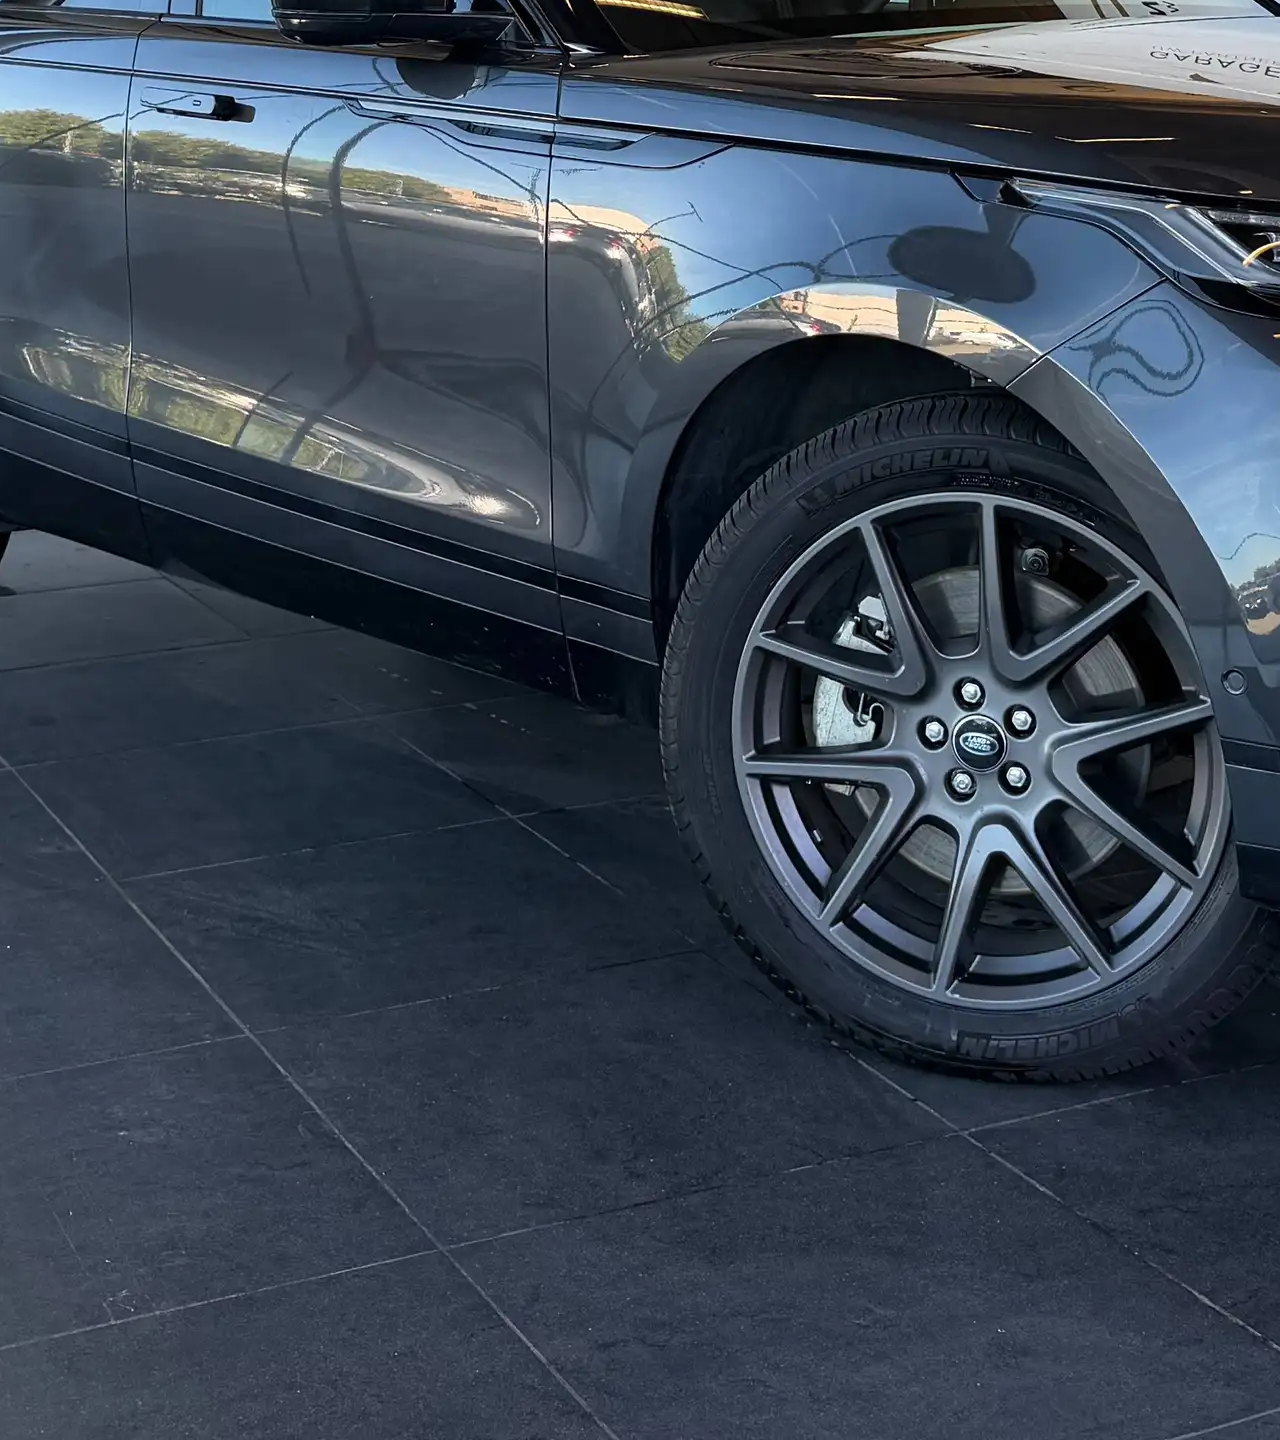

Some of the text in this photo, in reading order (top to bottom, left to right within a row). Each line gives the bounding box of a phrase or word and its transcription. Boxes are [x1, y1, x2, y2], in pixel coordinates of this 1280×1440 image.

[835, 447, 990, 495] MICHELIN
[968, 735, 987, 745] LAND
[969, 742, 991, 751] ROVER
